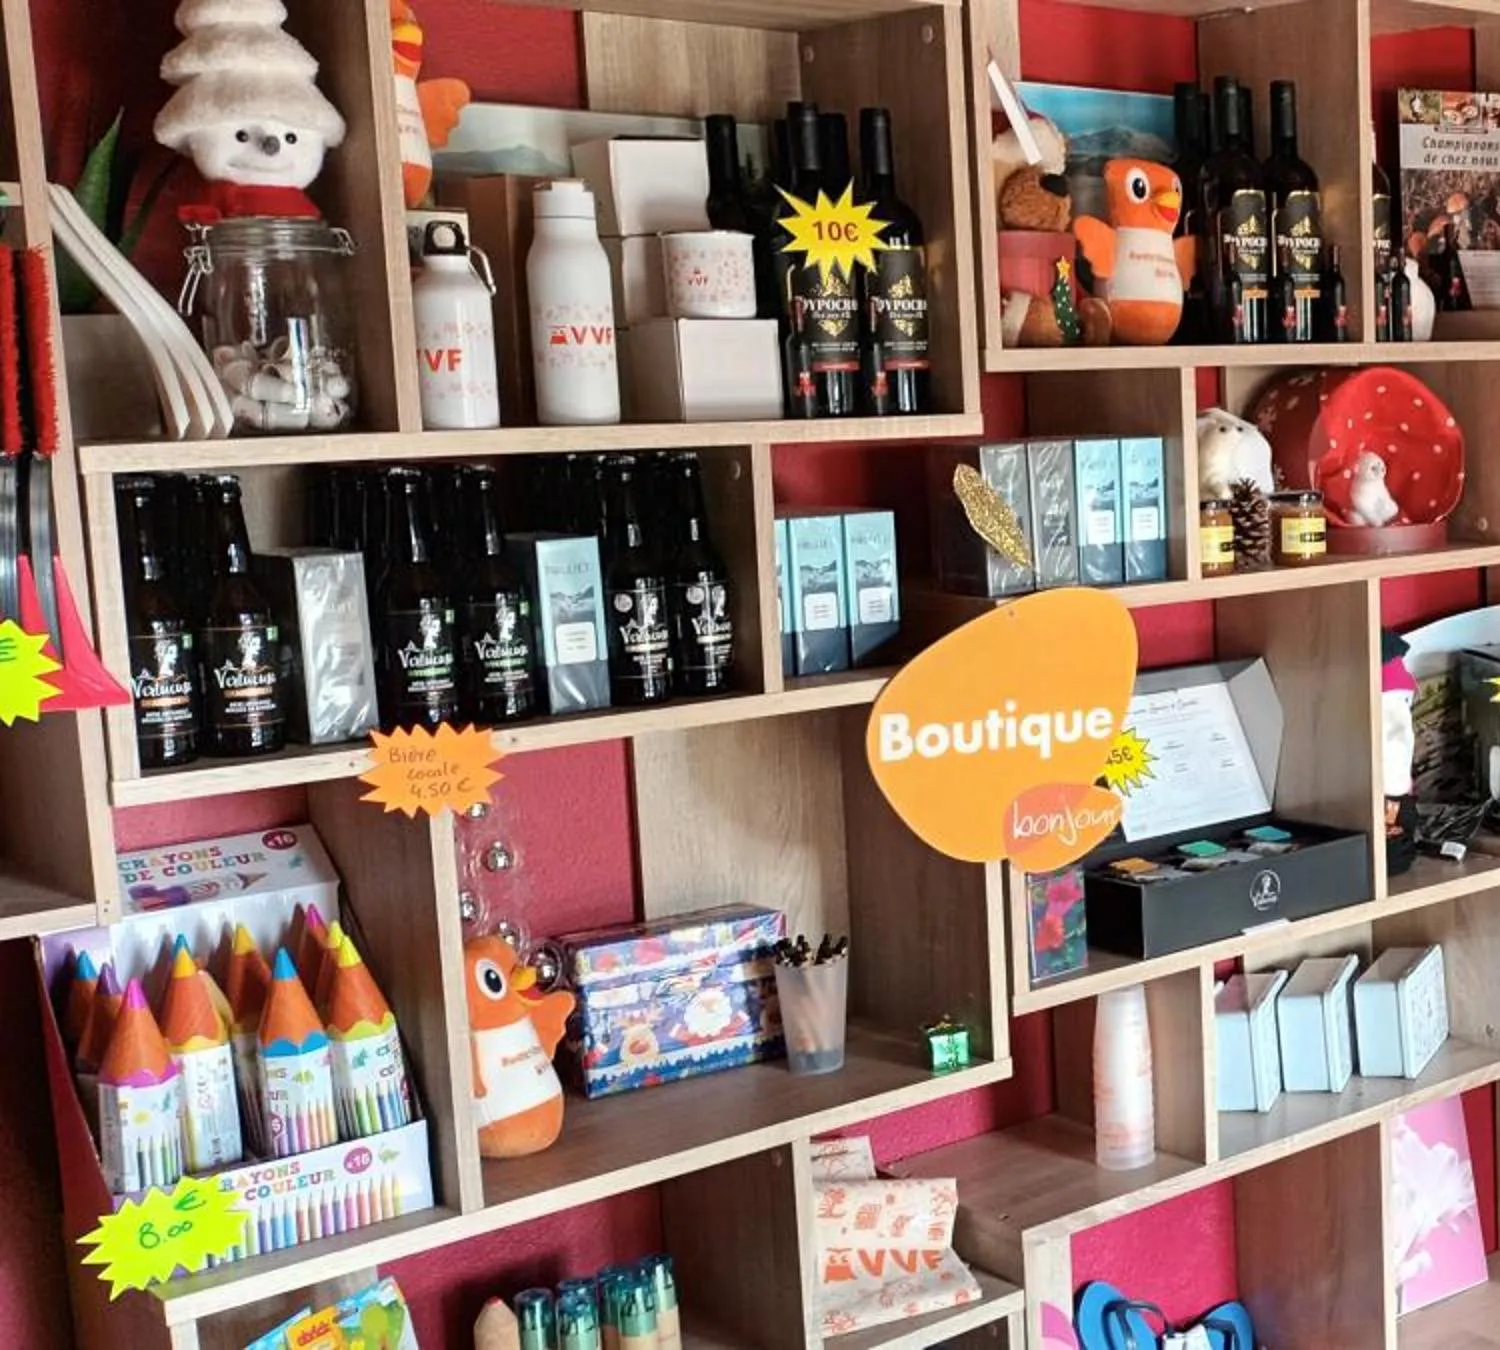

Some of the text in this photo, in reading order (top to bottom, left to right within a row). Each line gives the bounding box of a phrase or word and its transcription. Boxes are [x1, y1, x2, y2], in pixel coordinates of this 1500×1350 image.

[1421, 135, 1500, 153] Champignons
[1423, 154, 1439, 165] de
[1442, 155, 1469, 166] chez
[812, 220, 859, 242] 10€
[416, 348, 462, 372] VF
[879, 699, 1114, 762] Boutique
[388, 746, 437, 763] Bière
[1011, 797, 1120, 847] bonjour
[117, 846, 223, 872] CRAYONS
[121, 852, 267, 884] DE COULEUR
[221, 1161, 301, 1192] RAYONS
[243, 1170, 336, 1202] COULEUR
[173, 1189, 206, 1212] €
